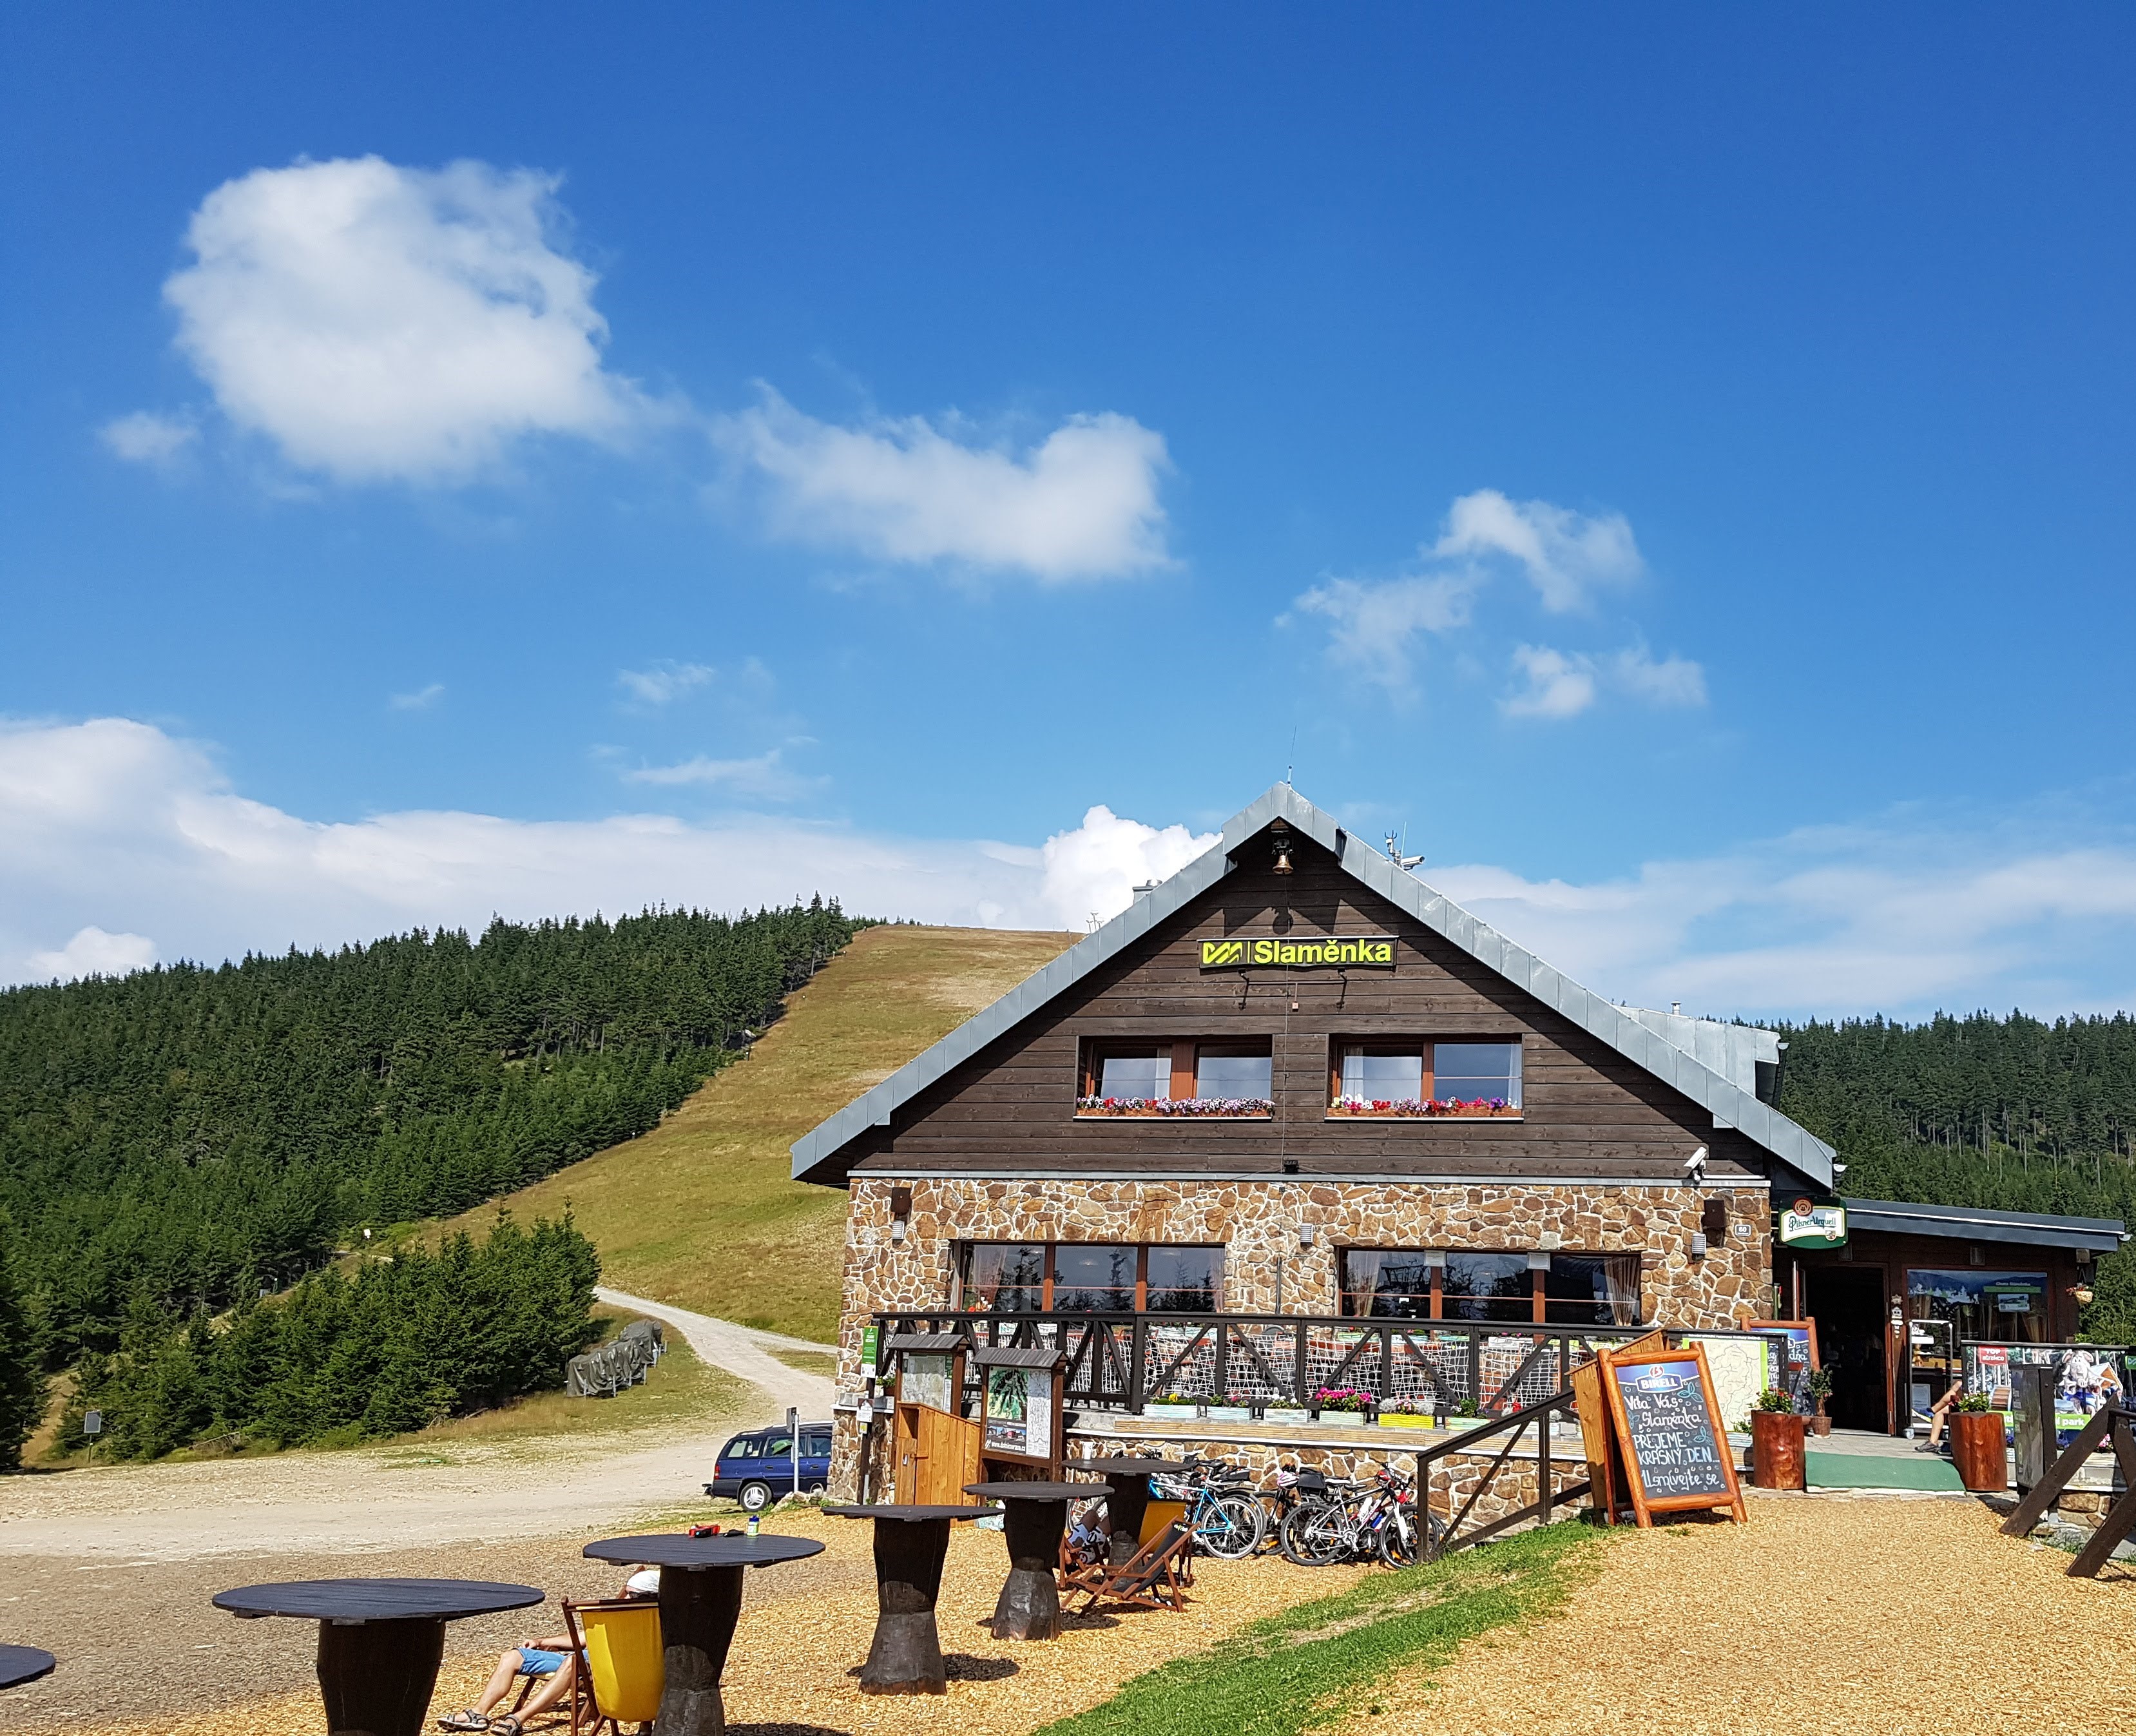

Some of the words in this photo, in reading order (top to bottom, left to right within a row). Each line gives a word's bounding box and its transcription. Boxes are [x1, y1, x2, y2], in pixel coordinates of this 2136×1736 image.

[1254, 939, 1392, 965] Slaměnka
[1789, 1216, 1813, 1231] Pilsner
[1813, 1215, 1836, 1229] Urquell
[1640, 1378, 1678, 1389] BIRELL
[1632, 1430, 1687, 1449] PŘEJEME
[1706, 1474, 1719, 1485] se
